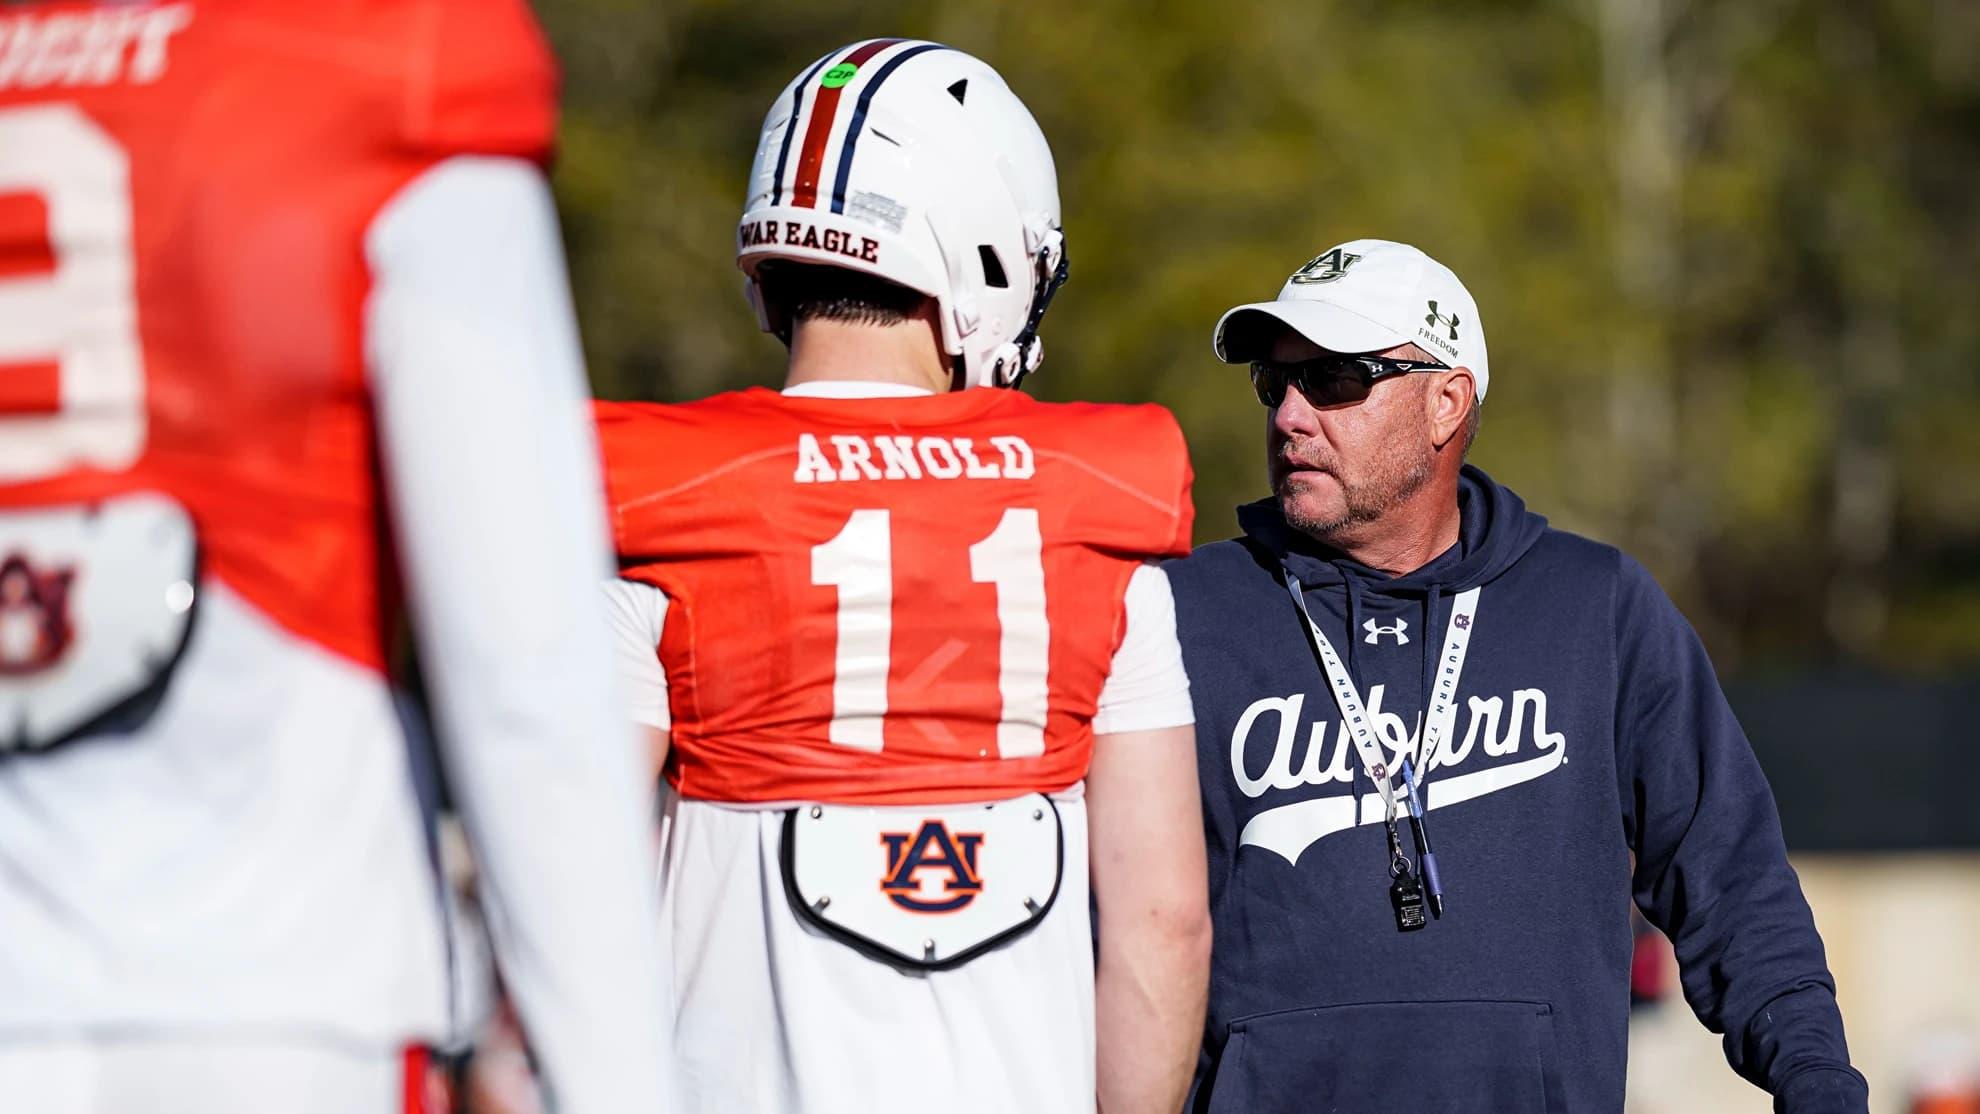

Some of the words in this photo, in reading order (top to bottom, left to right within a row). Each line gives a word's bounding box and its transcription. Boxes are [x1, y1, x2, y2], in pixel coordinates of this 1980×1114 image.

[740, 221, 778, 248] WAR
[785, 222, 880, 263] EAGLE
[1418, 327, 1458, 359] FREEDOM
[794, 433, 1035, 482] ARNOLD
[811, 508, 1050, 760] 11
[1436, 642, 1460, 713] AUBURN
[1337, 678, 1373, 748] AUBURN
